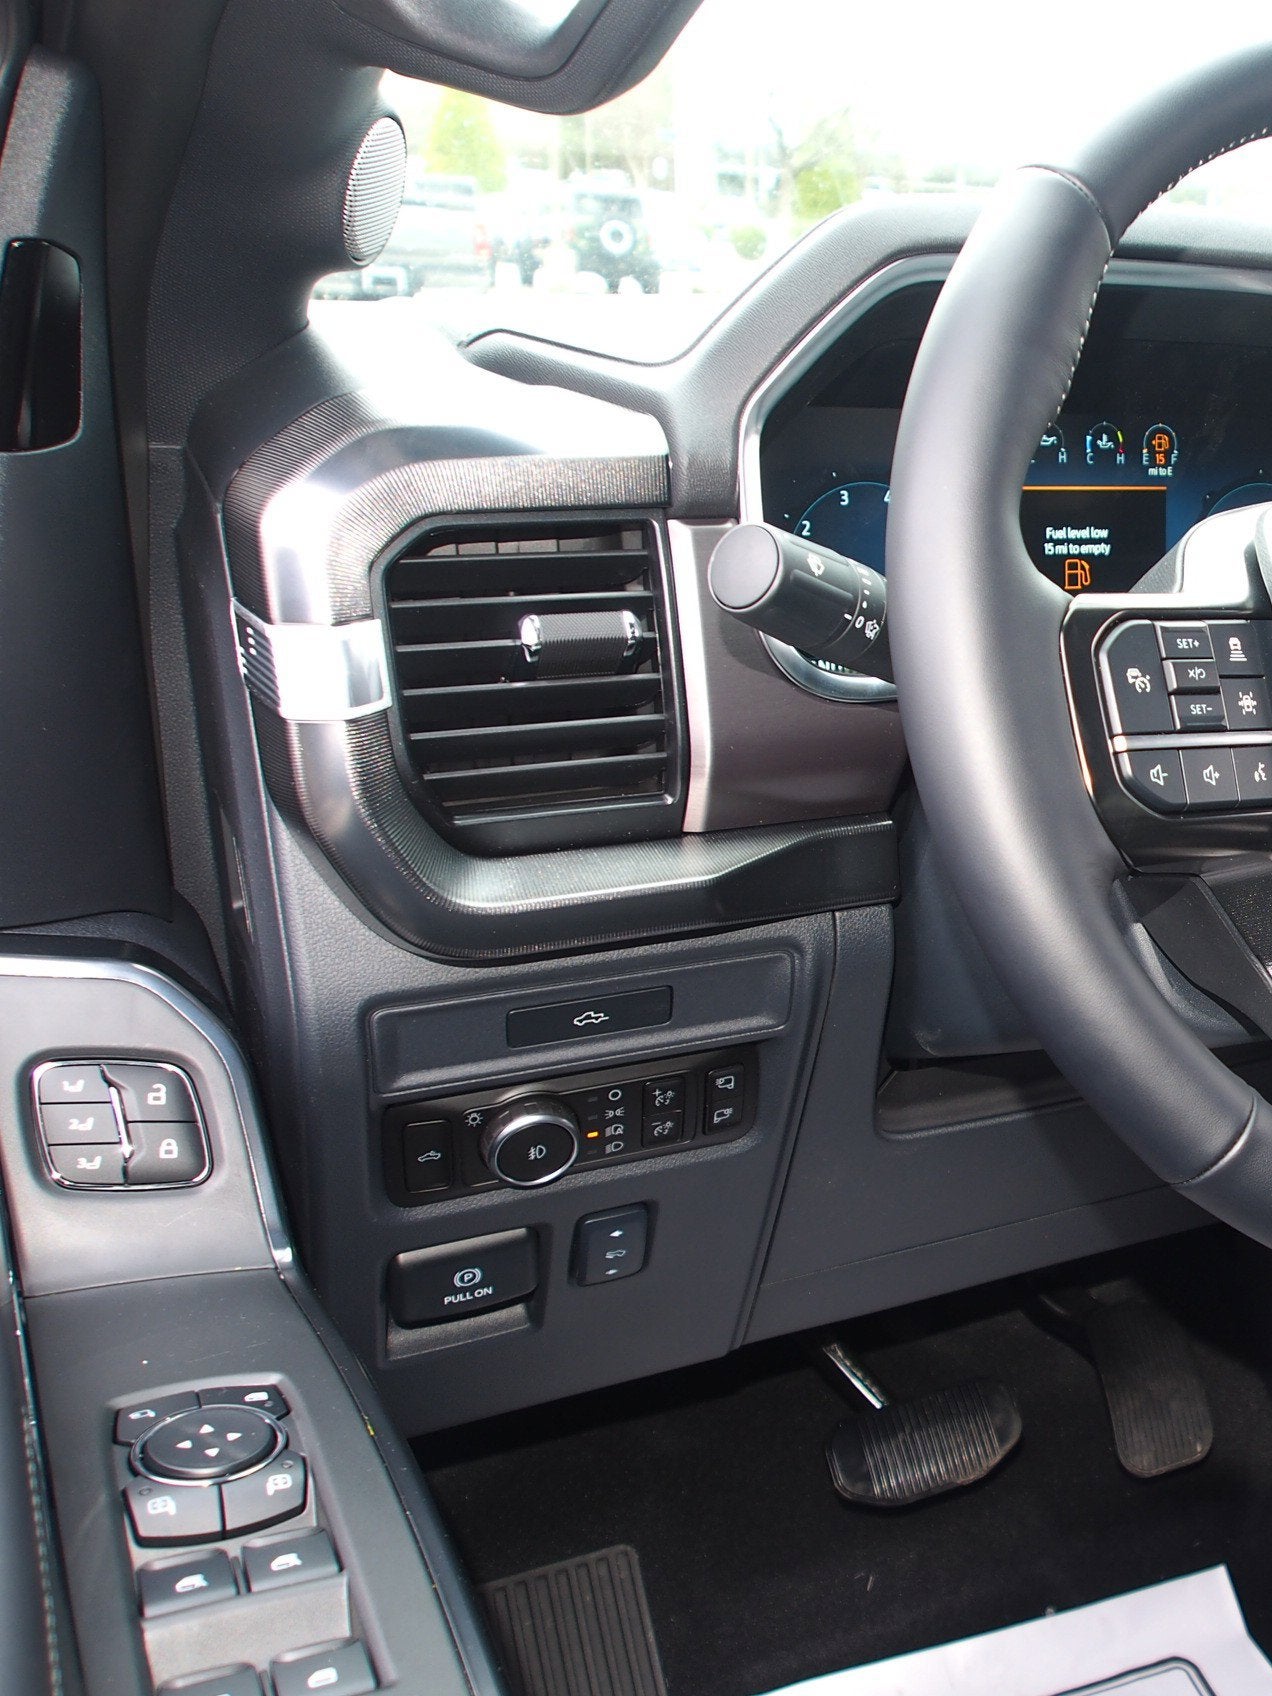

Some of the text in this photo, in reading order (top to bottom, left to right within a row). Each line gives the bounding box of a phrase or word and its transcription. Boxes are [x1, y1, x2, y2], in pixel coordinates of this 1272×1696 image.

[1058, 451, 1067, 463] H
[1086, 453, 1095, 464] C
[1116, 453, 1125, 464] H
[1142, 453, 1150, 465] E
[1155, 453, 1166, 464] 15
[1171, 453, 1178, 465] F
[1148, 466, 1173, 476] mi to E
[839, 490, 849, 506] 3
[801, 520, 811, 536] 2
[1045, 526, 1109, 540] Fuel level low
[1044, 542, 1111, 556] 15 mi to empty
[1176, 638, 1200, 649] SET+
[68, 1118, 80, 1130] 2
[444, 1286, 493, 1305] PULL ON
